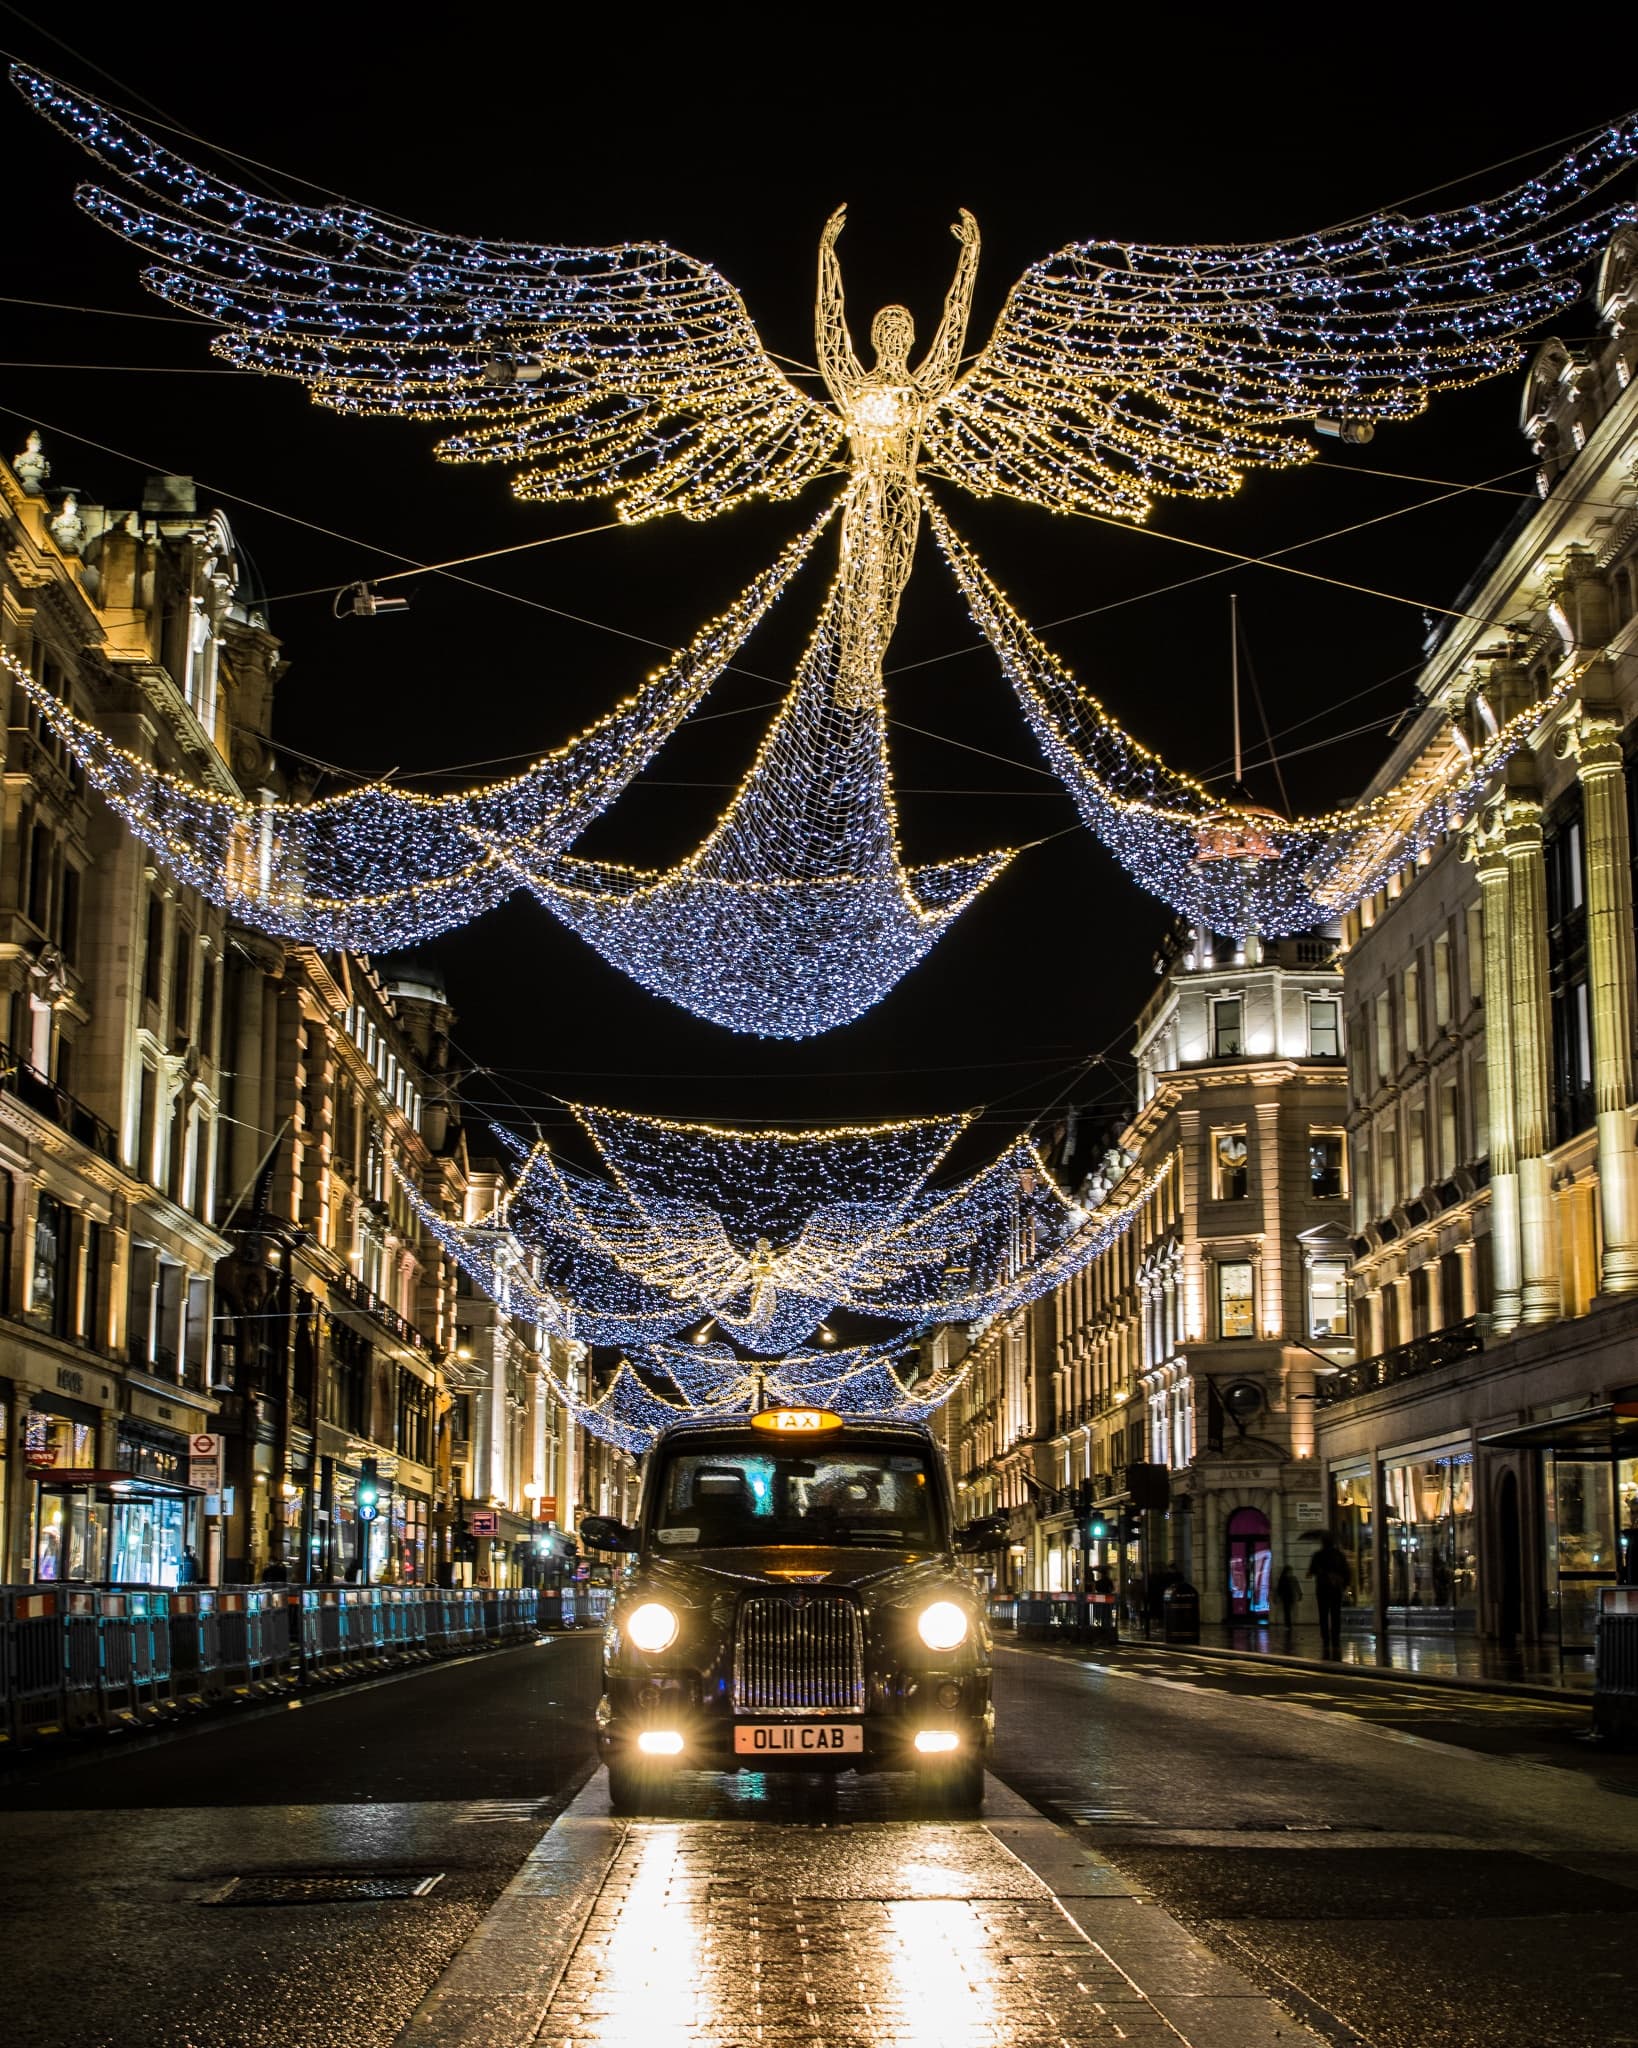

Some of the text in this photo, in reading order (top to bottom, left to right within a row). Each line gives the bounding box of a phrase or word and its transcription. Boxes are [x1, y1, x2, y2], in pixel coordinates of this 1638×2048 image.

[771, 1415, 823, 1428] TAXI
[754, 1728, 844, 1749] OL11 CAB
